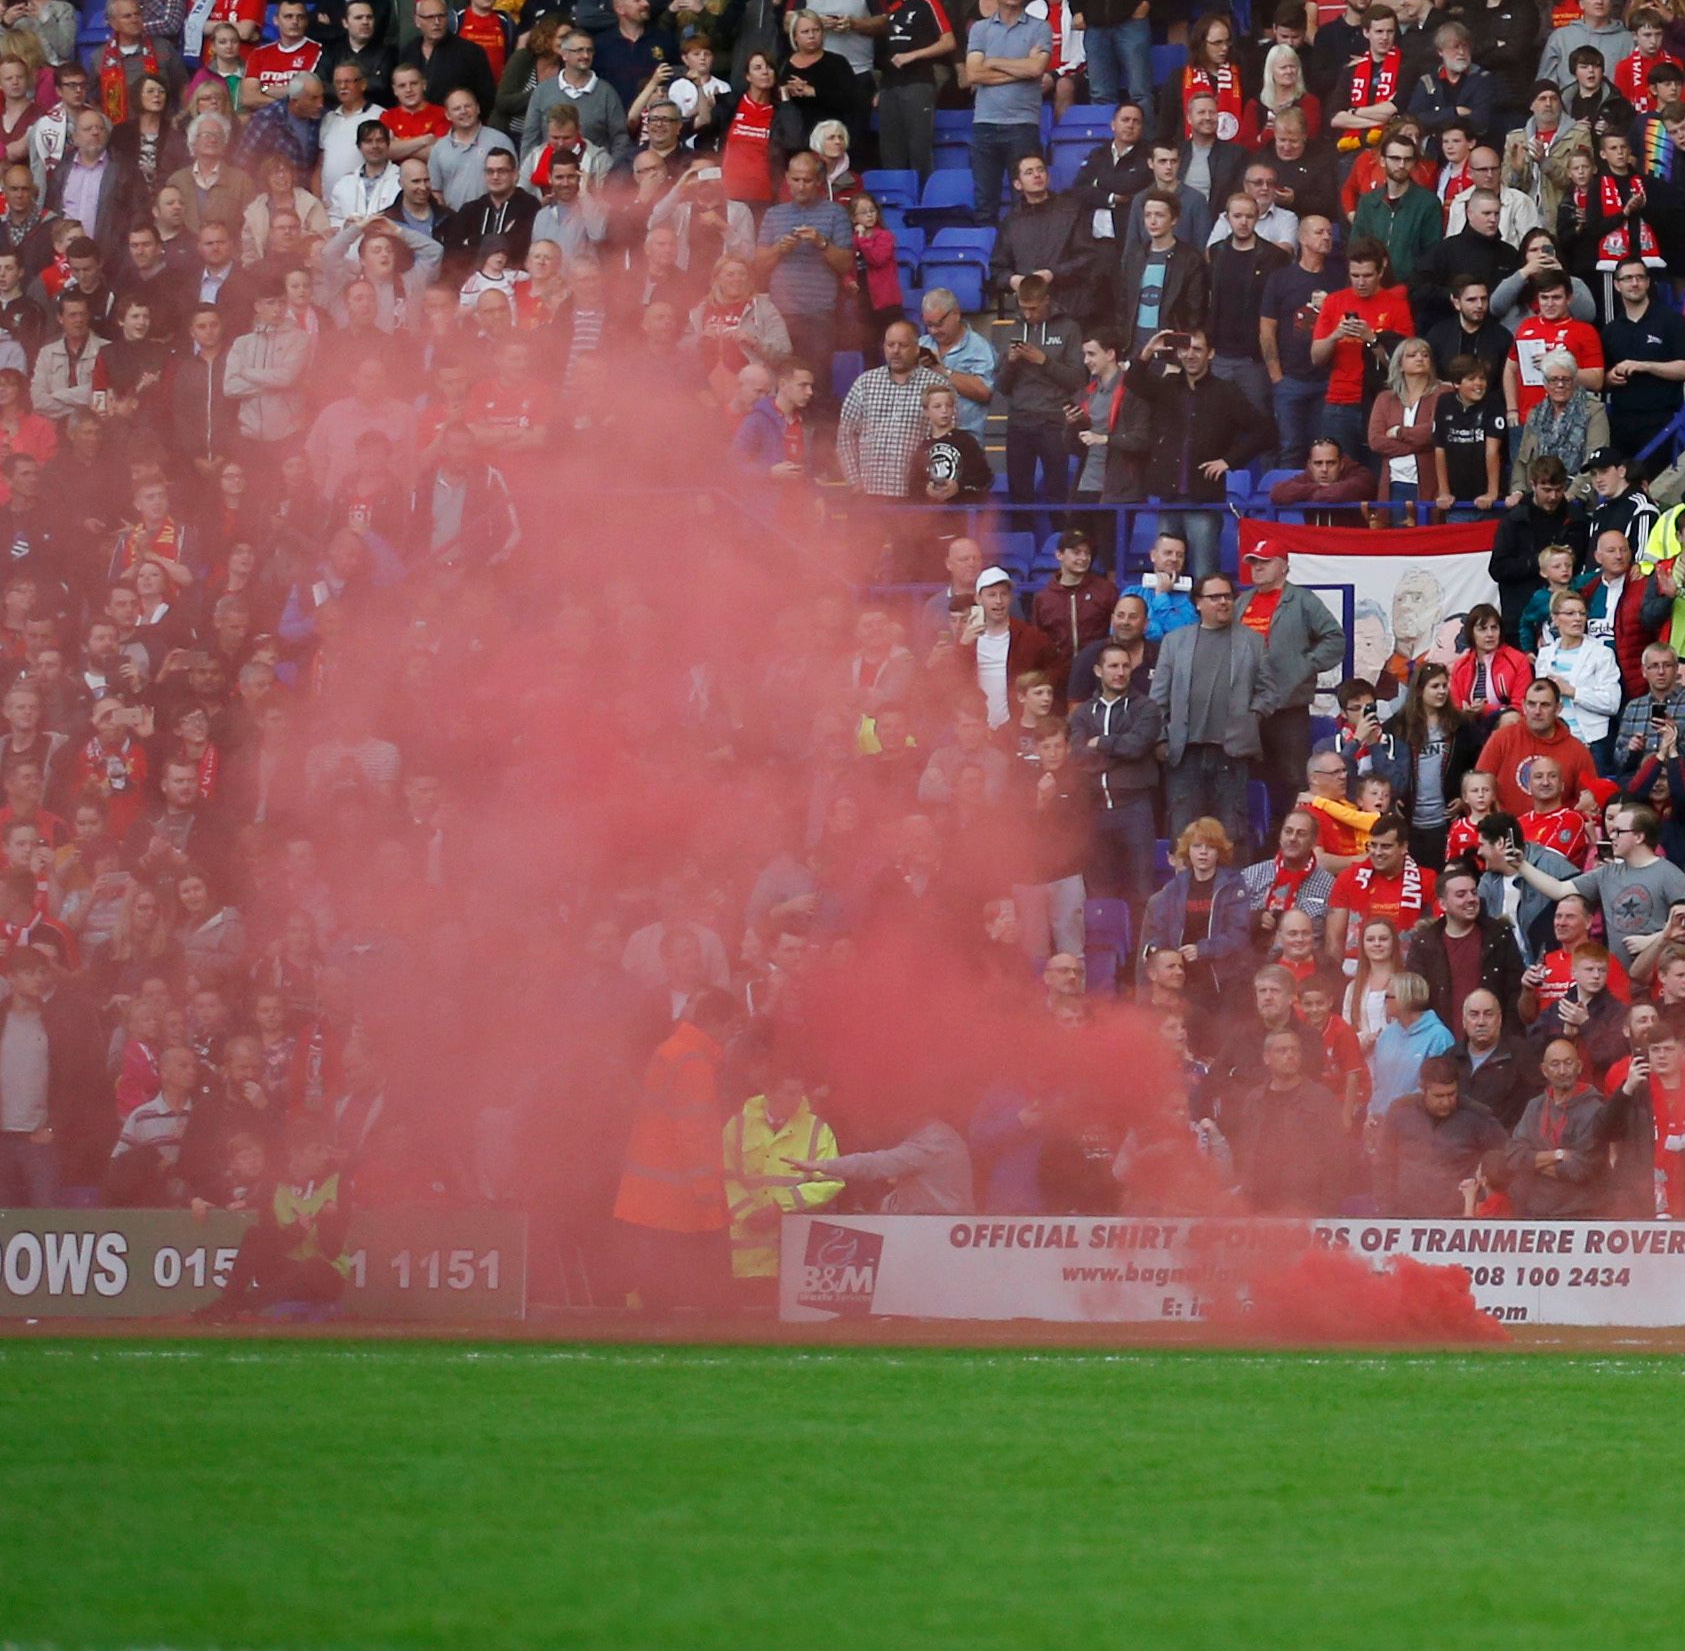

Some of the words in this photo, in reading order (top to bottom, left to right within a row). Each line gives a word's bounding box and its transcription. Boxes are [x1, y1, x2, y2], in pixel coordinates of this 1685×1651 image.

[1421, 742, 1451, 756] ANS
[1400, 857, 1423, 911] LIVER
[950, 1223, 1079, 1249] OFFICIAL
[1088, 1224, 1179, 1249] SHIRT
[1361, 1227, 1402, 1252] OF
[1411, 1228, 1575, 1255] TRANMERE
[0, 1231, 129, 1297] OWS
[391, 1248, 500, 1290] 1151
[1516, 1267, 1560, 1288] 100
[1567, 1267, 1631, 1288] 2434
[801, 1265, 874, 1294] B&M
